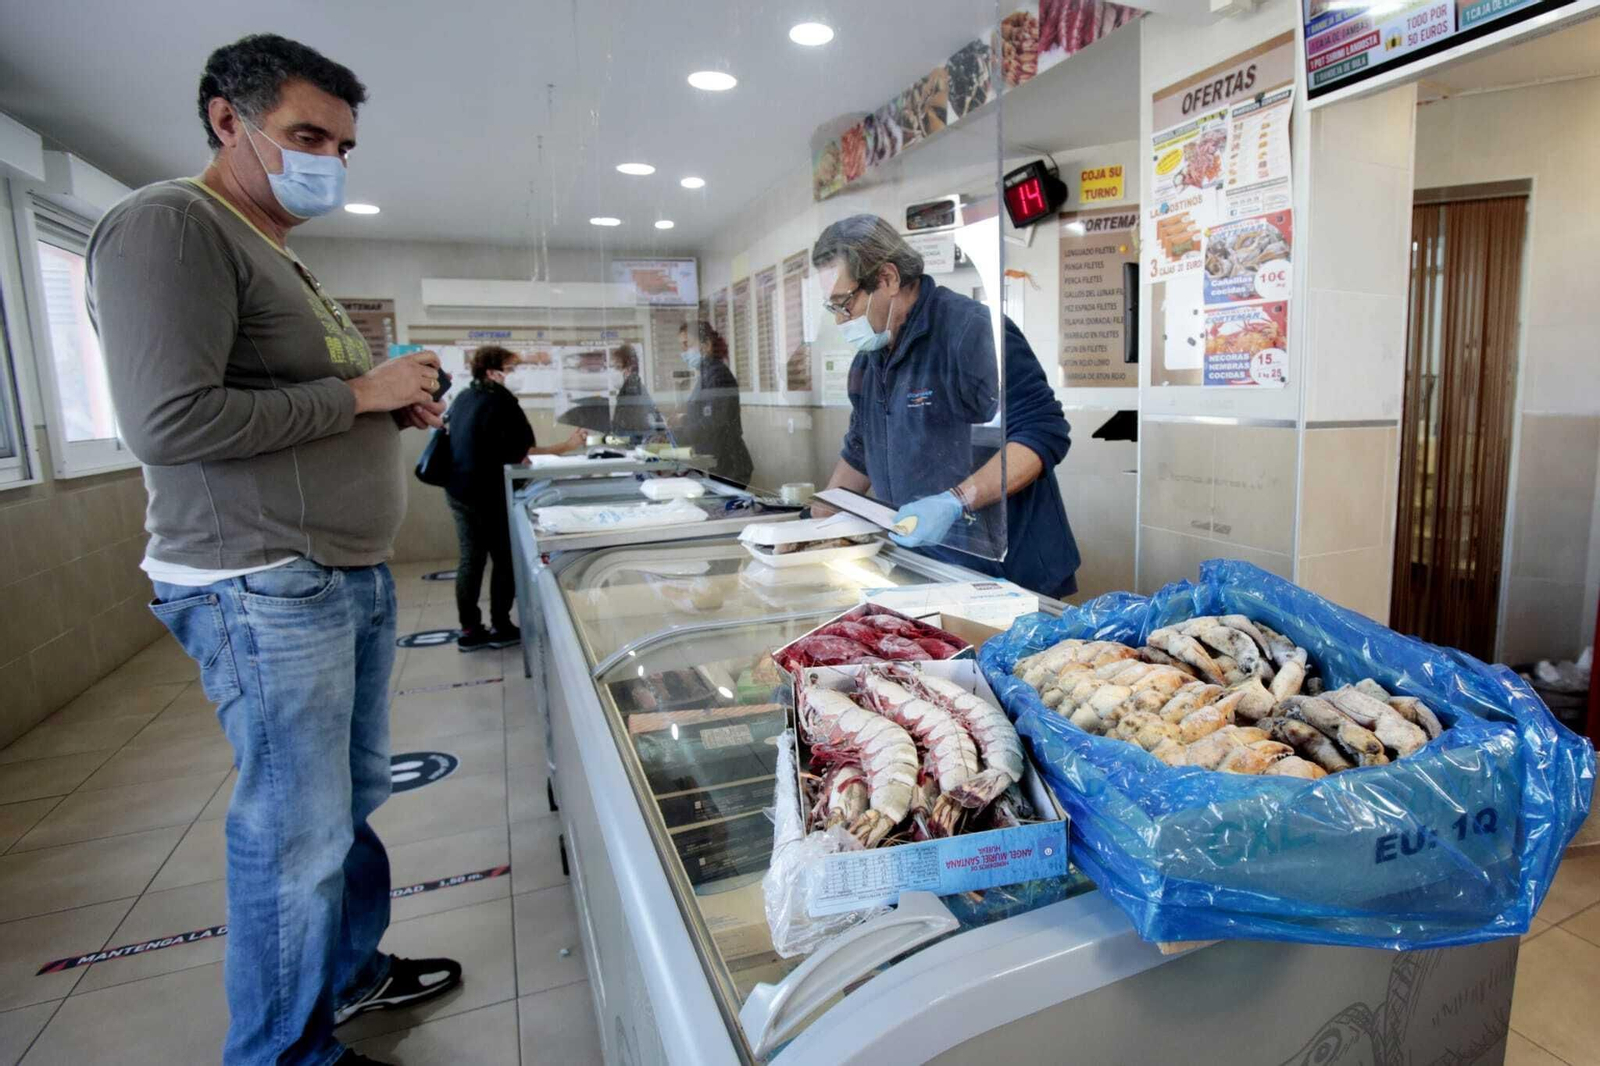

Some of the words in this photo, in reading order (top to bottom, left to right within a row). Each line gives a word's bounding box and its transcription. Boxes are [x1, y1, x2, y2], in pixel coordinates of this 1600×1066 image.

[1407, 12, 1428, 30] TODO
[1430, 4, 1448, 21] POR
[1470, 4, 1491, 20] CAJA
[1408, 33, 1418, 46] 50
[1420, 21, 1448, 41] EUROS
[1182, 65, 1257, 115] OFERTAS
[1081, 169, 1106, 182] COJA
[1109, 166, 1122, 178] SU
[1019, 177, 1043, 215] 14
[1085, 186, 1118, 200] TURNO
[1064, 248, 1094, 258] LENGUADO
[1095, 245, 1116, 255] FILETES
[1064, 262, 1082, 271] PANGA
[1084, 261, 1105, 269] FILETES
[1150, 258, 1158, 277] 3
[1064, 276, 1081, 285] PERCA
[1082, 275, 1103, 284] FILETES
[1259, 270, 1286, 283] 10€
[1097, 302, 1117, 310] FILETES
[1099, 330, 1119, 338] FILETES
[1208, 353, 1251, 363] NECORAS
[1258, 353, 1273, 364] 15
[1208, 371, 1246, 381] COCIDAS
[1271, 368, 1282, 378] 25
[982, 851, 1007, 864] MURIEL
[1010, 848, 1033, 860] ANGEL
[945, 855, 980, 869] SANTANA
[440, 876, 466, 887] 1.50
[77, 936, 184, 965] MANTENGA
[189, 930, 212, 941] LA
